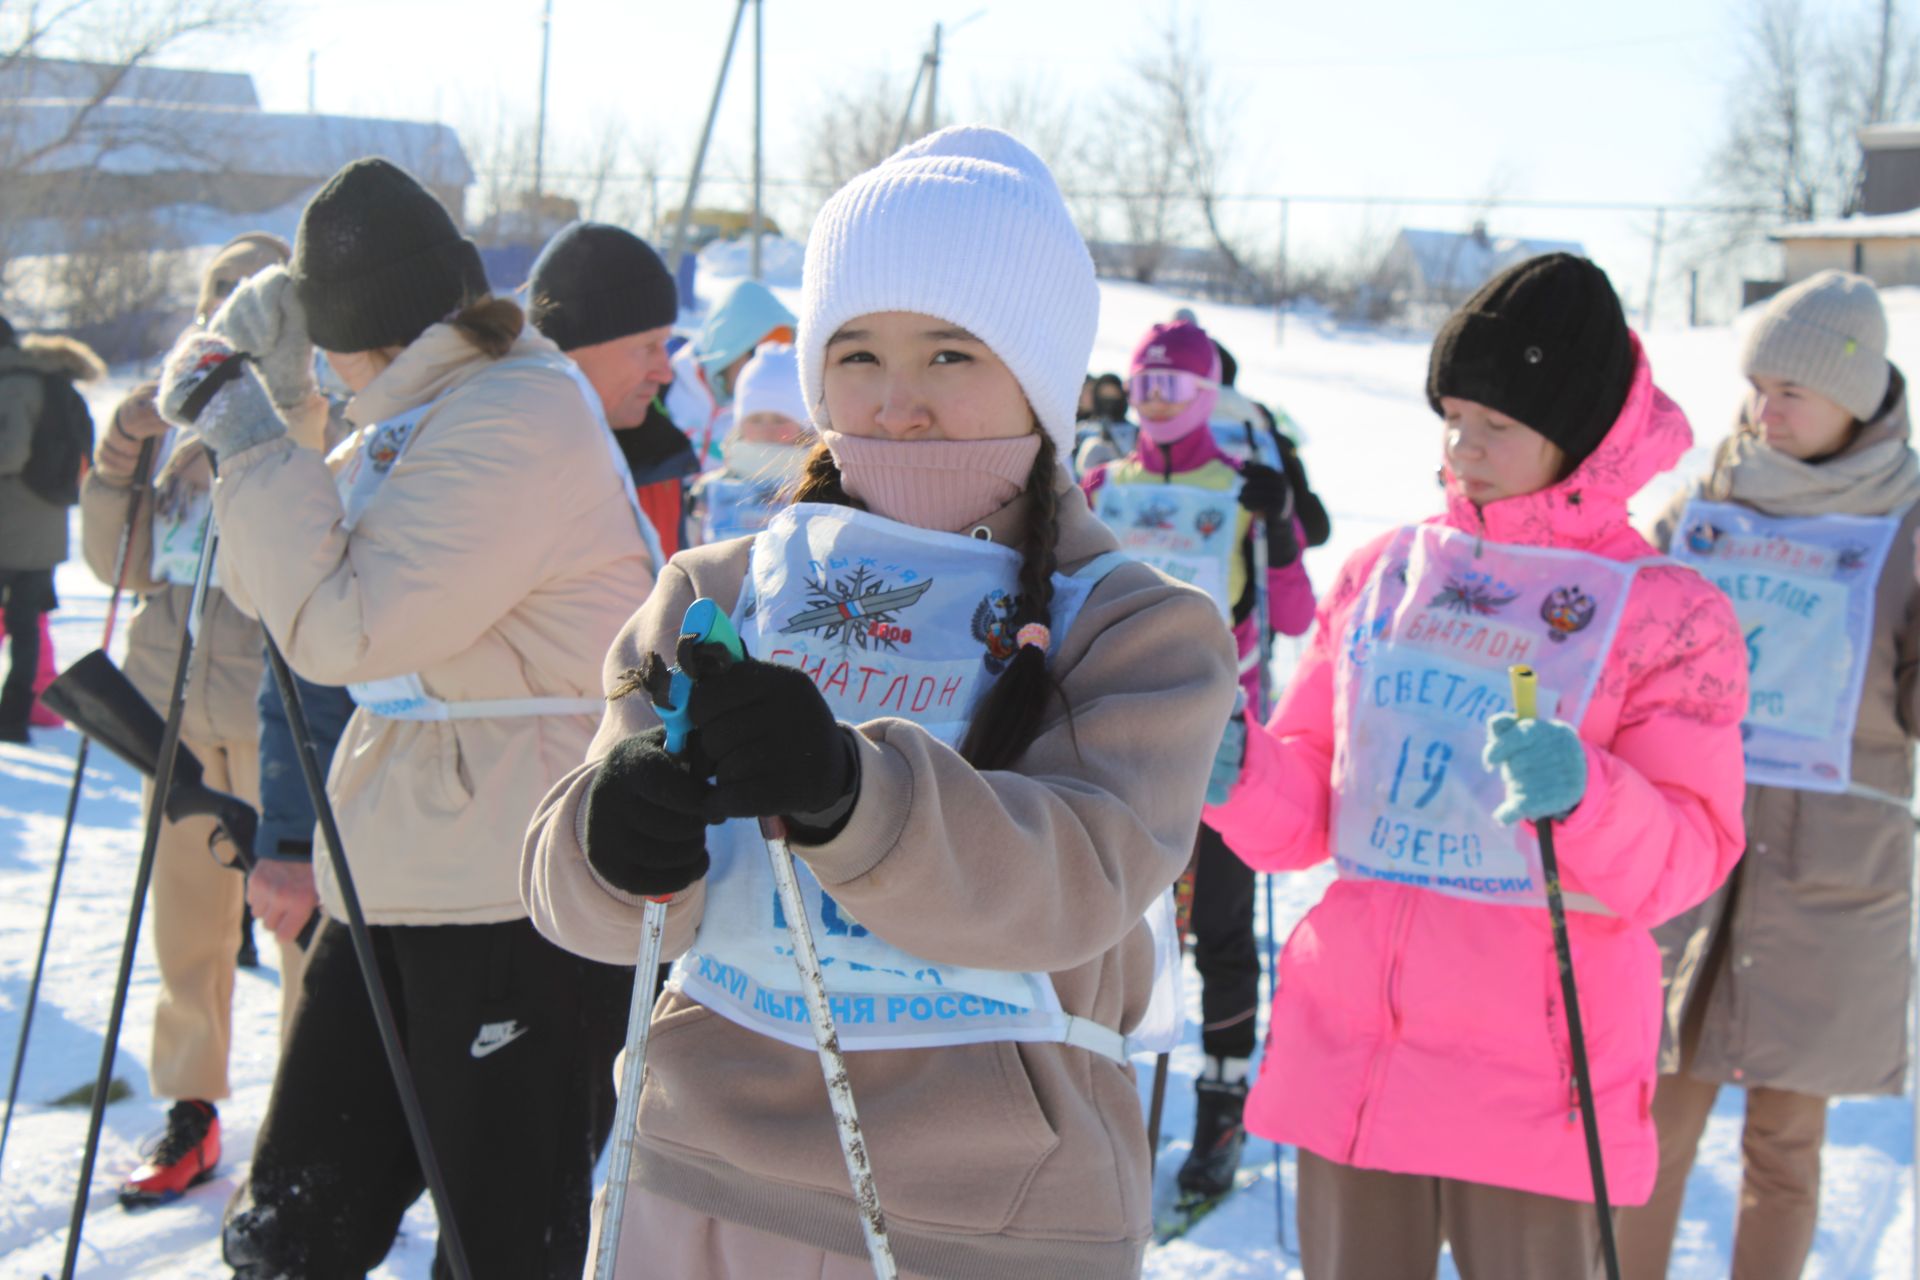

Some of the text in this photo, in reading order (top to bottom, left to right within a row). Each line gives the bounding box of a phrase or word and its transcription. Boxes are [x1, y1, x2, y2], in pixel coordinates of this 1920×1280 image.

[1714, 573, 1823, 618] ВЕТЛОЕ
[867, 621, 913, 644] 2008
[1374, 668, 1516, 722] СВЕТЛО
[1389, 735, 1453, 809] 19
[1369, 815, 1483, 868] ОЗЕРО
